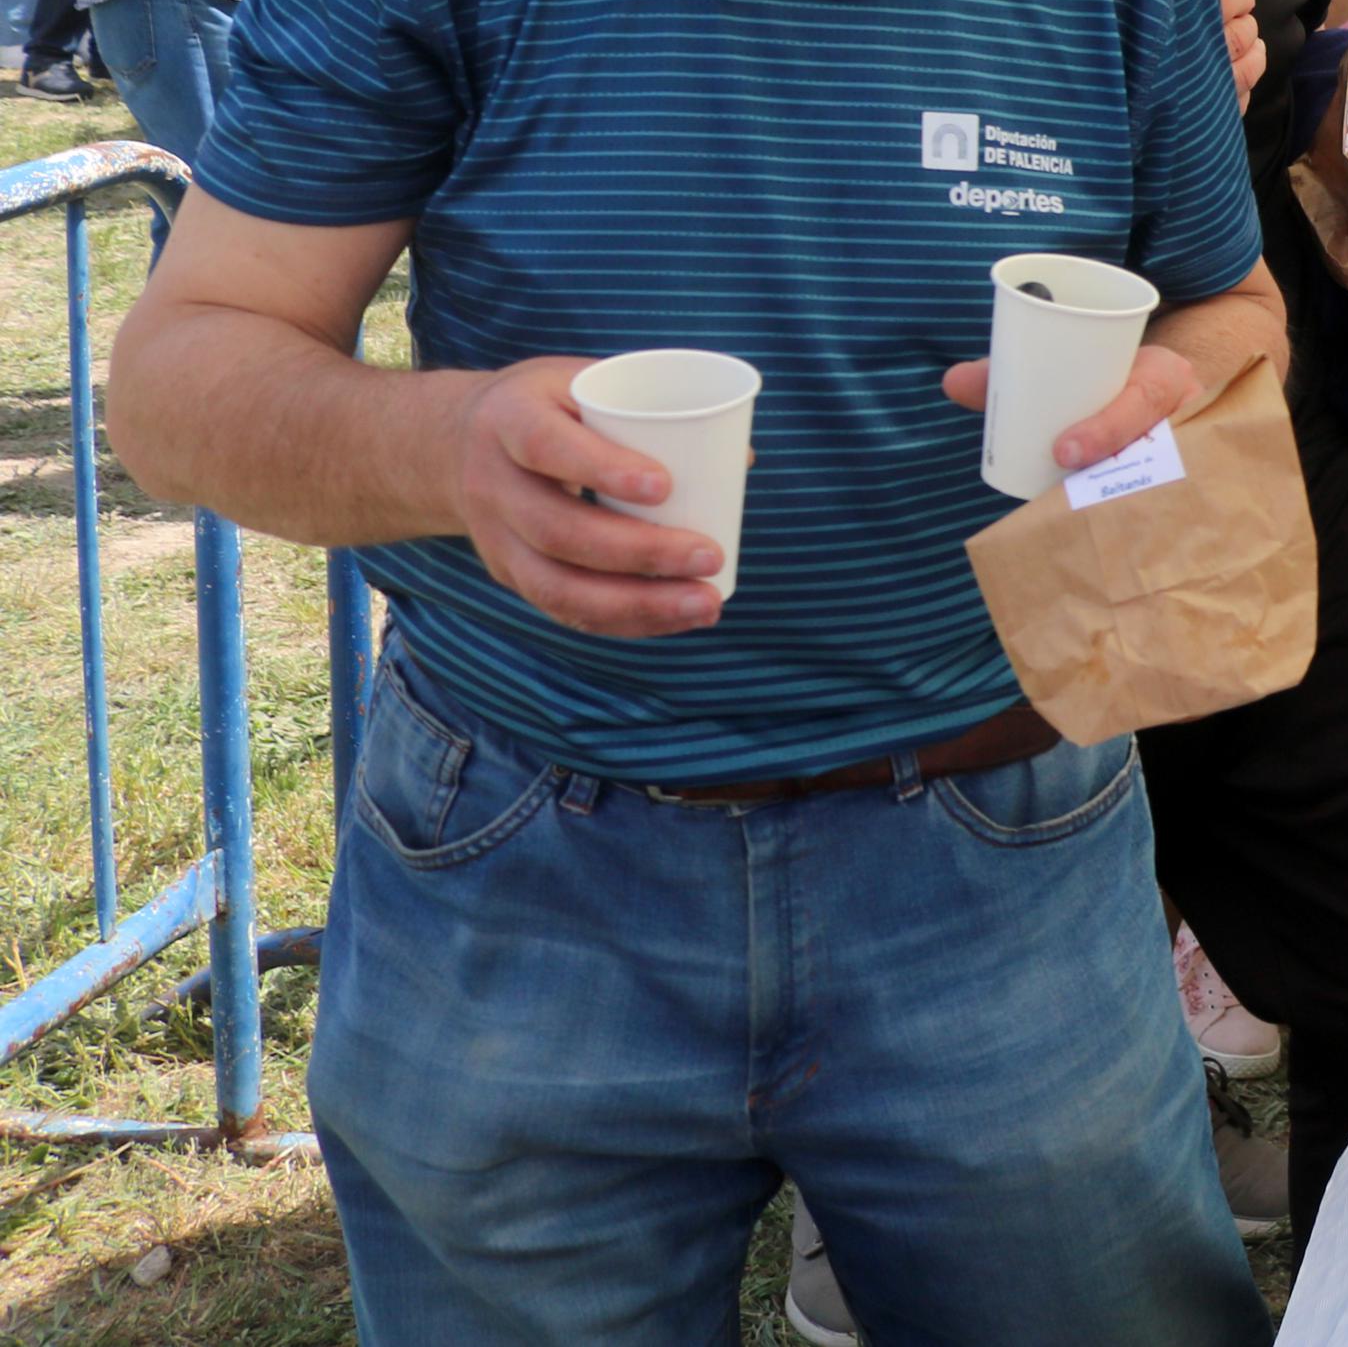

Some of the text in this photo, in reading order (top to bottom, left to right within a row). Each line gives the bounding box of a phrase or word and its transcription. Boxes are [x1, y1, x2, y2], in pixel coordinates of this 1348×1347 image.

[984, 124, 1057, 151] Diputación
[984, 146, 1074, 175] DE PALENCIA
[949, 180, 1065, 214] deportes
